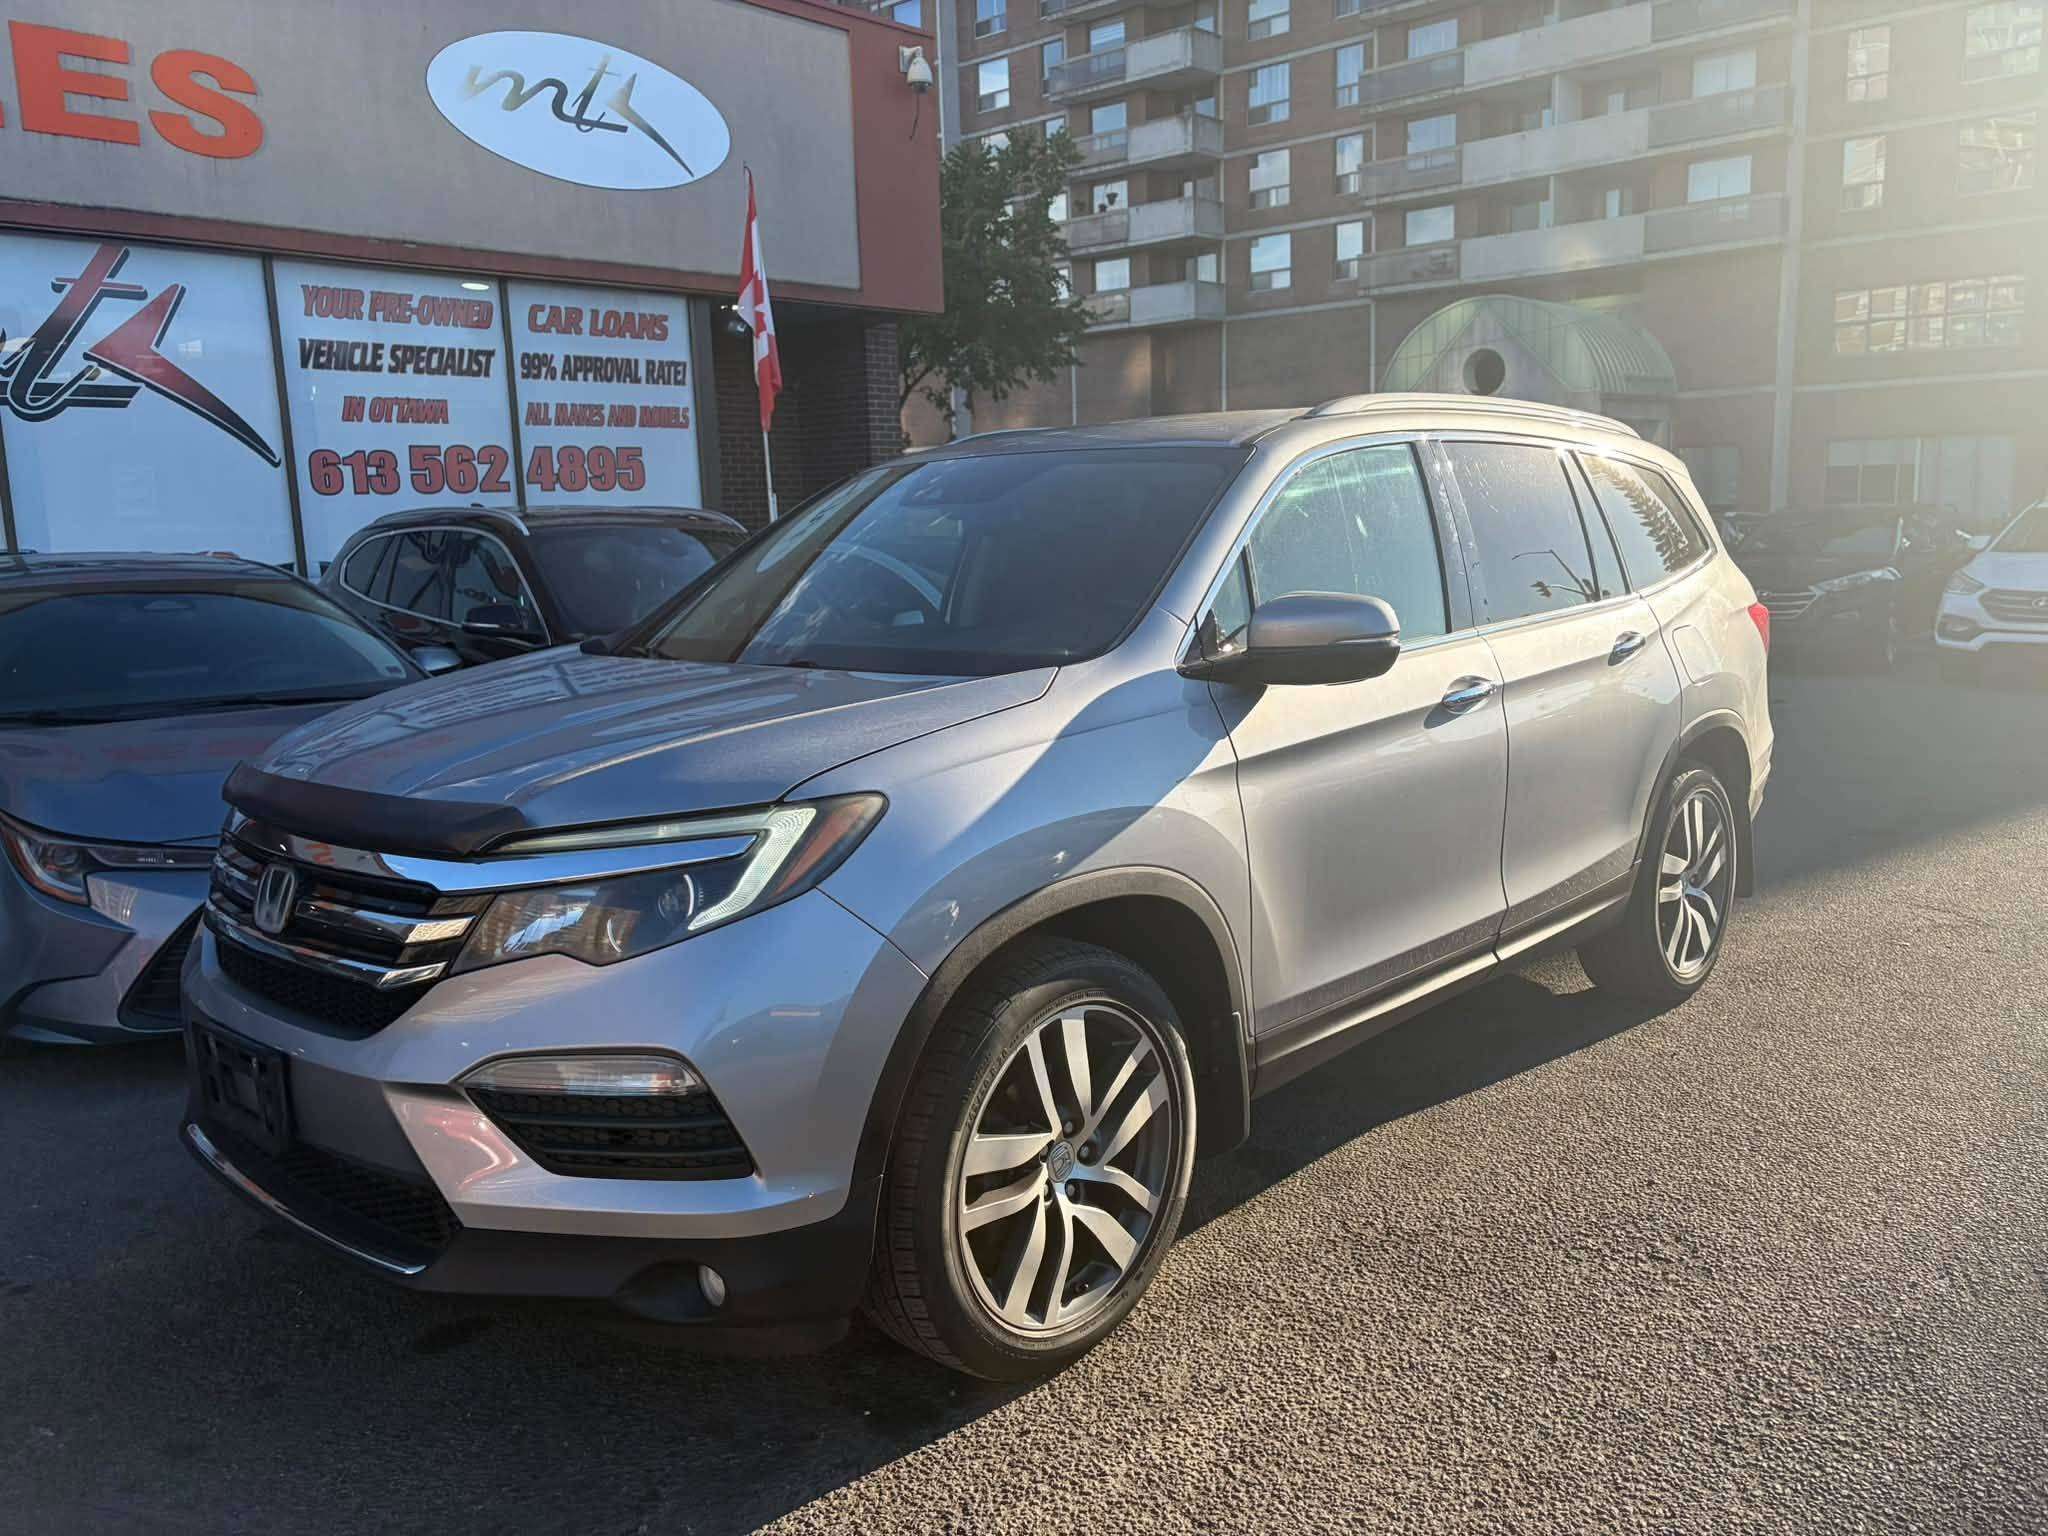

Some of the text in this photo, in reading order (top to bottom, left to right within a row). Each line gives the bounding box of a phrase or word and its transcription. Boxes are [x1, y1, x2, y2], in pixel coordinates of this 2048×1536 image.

[0, 20, 264, 159] ES
[301, 284, 494, 330] YOUR PRE-OWNED
[528, 304, 669, 341] CAR LOANS
[298, 338, 496, 377] VEHICLE SPECIALIST
[520, 353, 557, 380] 99%
[561, 355, 641, 384] APPROVAL
[342, 395, 449, 424] IN OTTAWA
[525, 402, 690, 429] ALL MAKES AND MODELS
[308, 445, 646, 495] 613 562 4895
